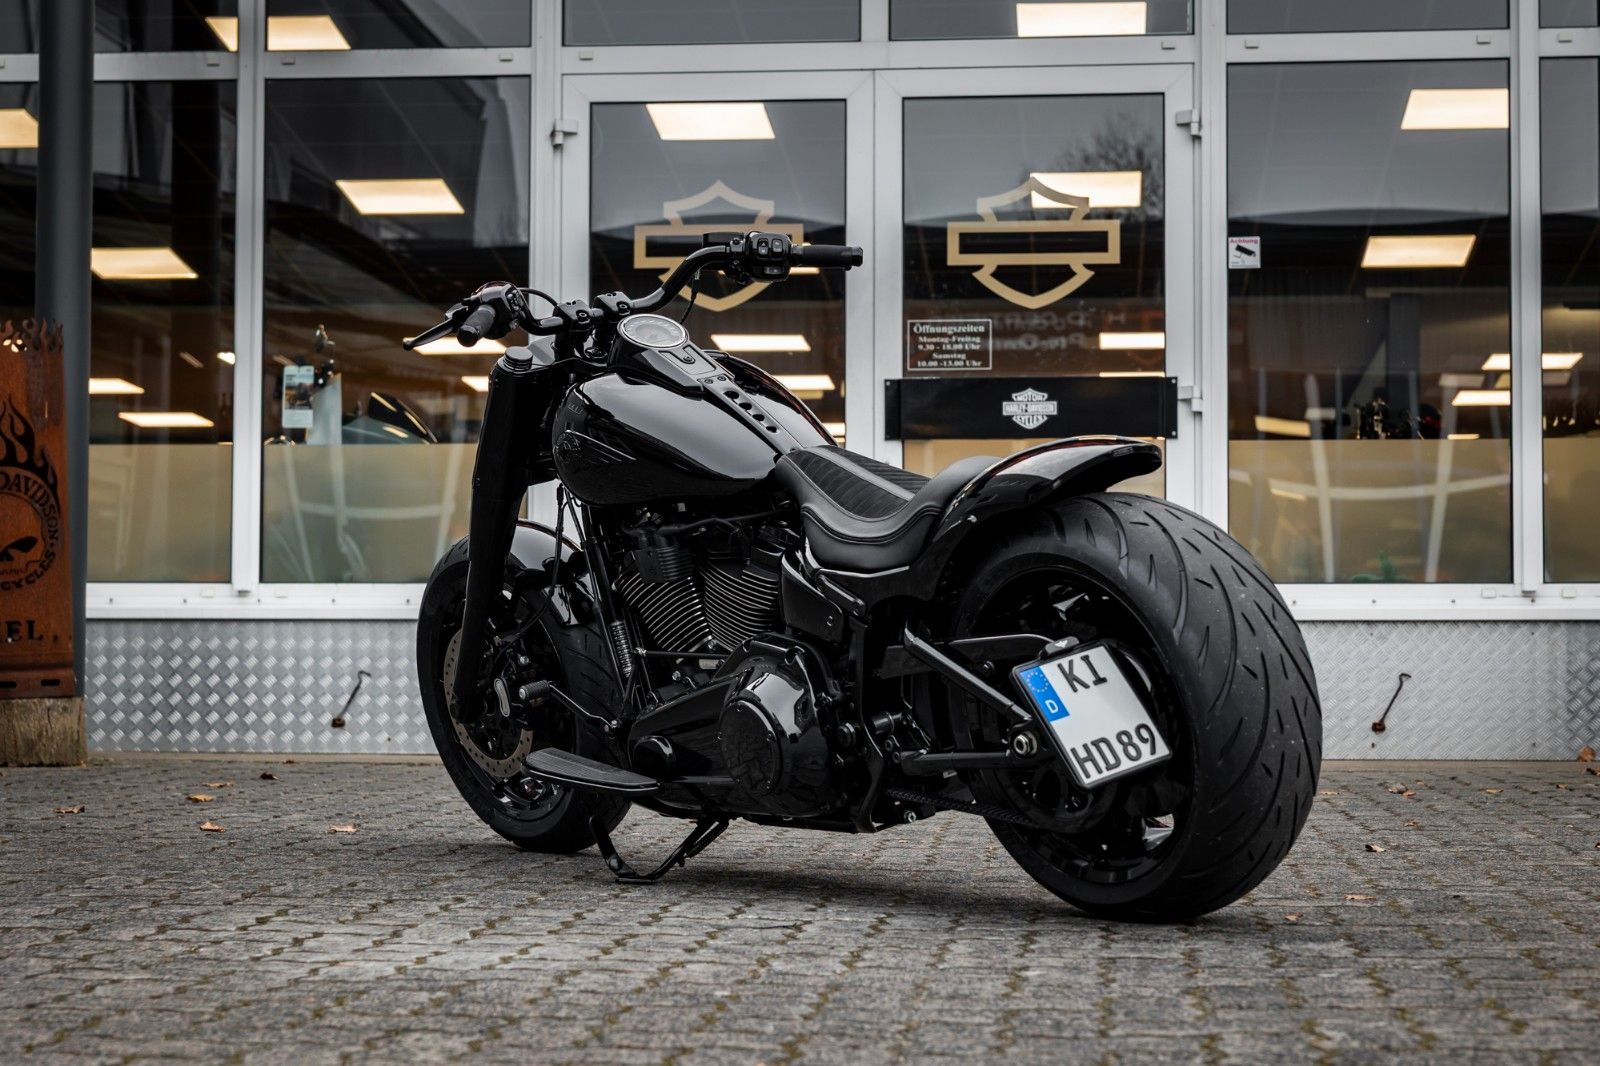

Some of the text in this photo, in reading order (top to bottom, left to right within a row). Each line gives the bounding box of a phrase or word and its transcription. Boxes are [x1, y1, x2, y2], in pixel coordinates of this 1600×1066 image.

[913, 323, 985, 335] Öffnungszeiten
[1057, 655, 1108, 693] KI
[1045, 699, 1059, 714] D
